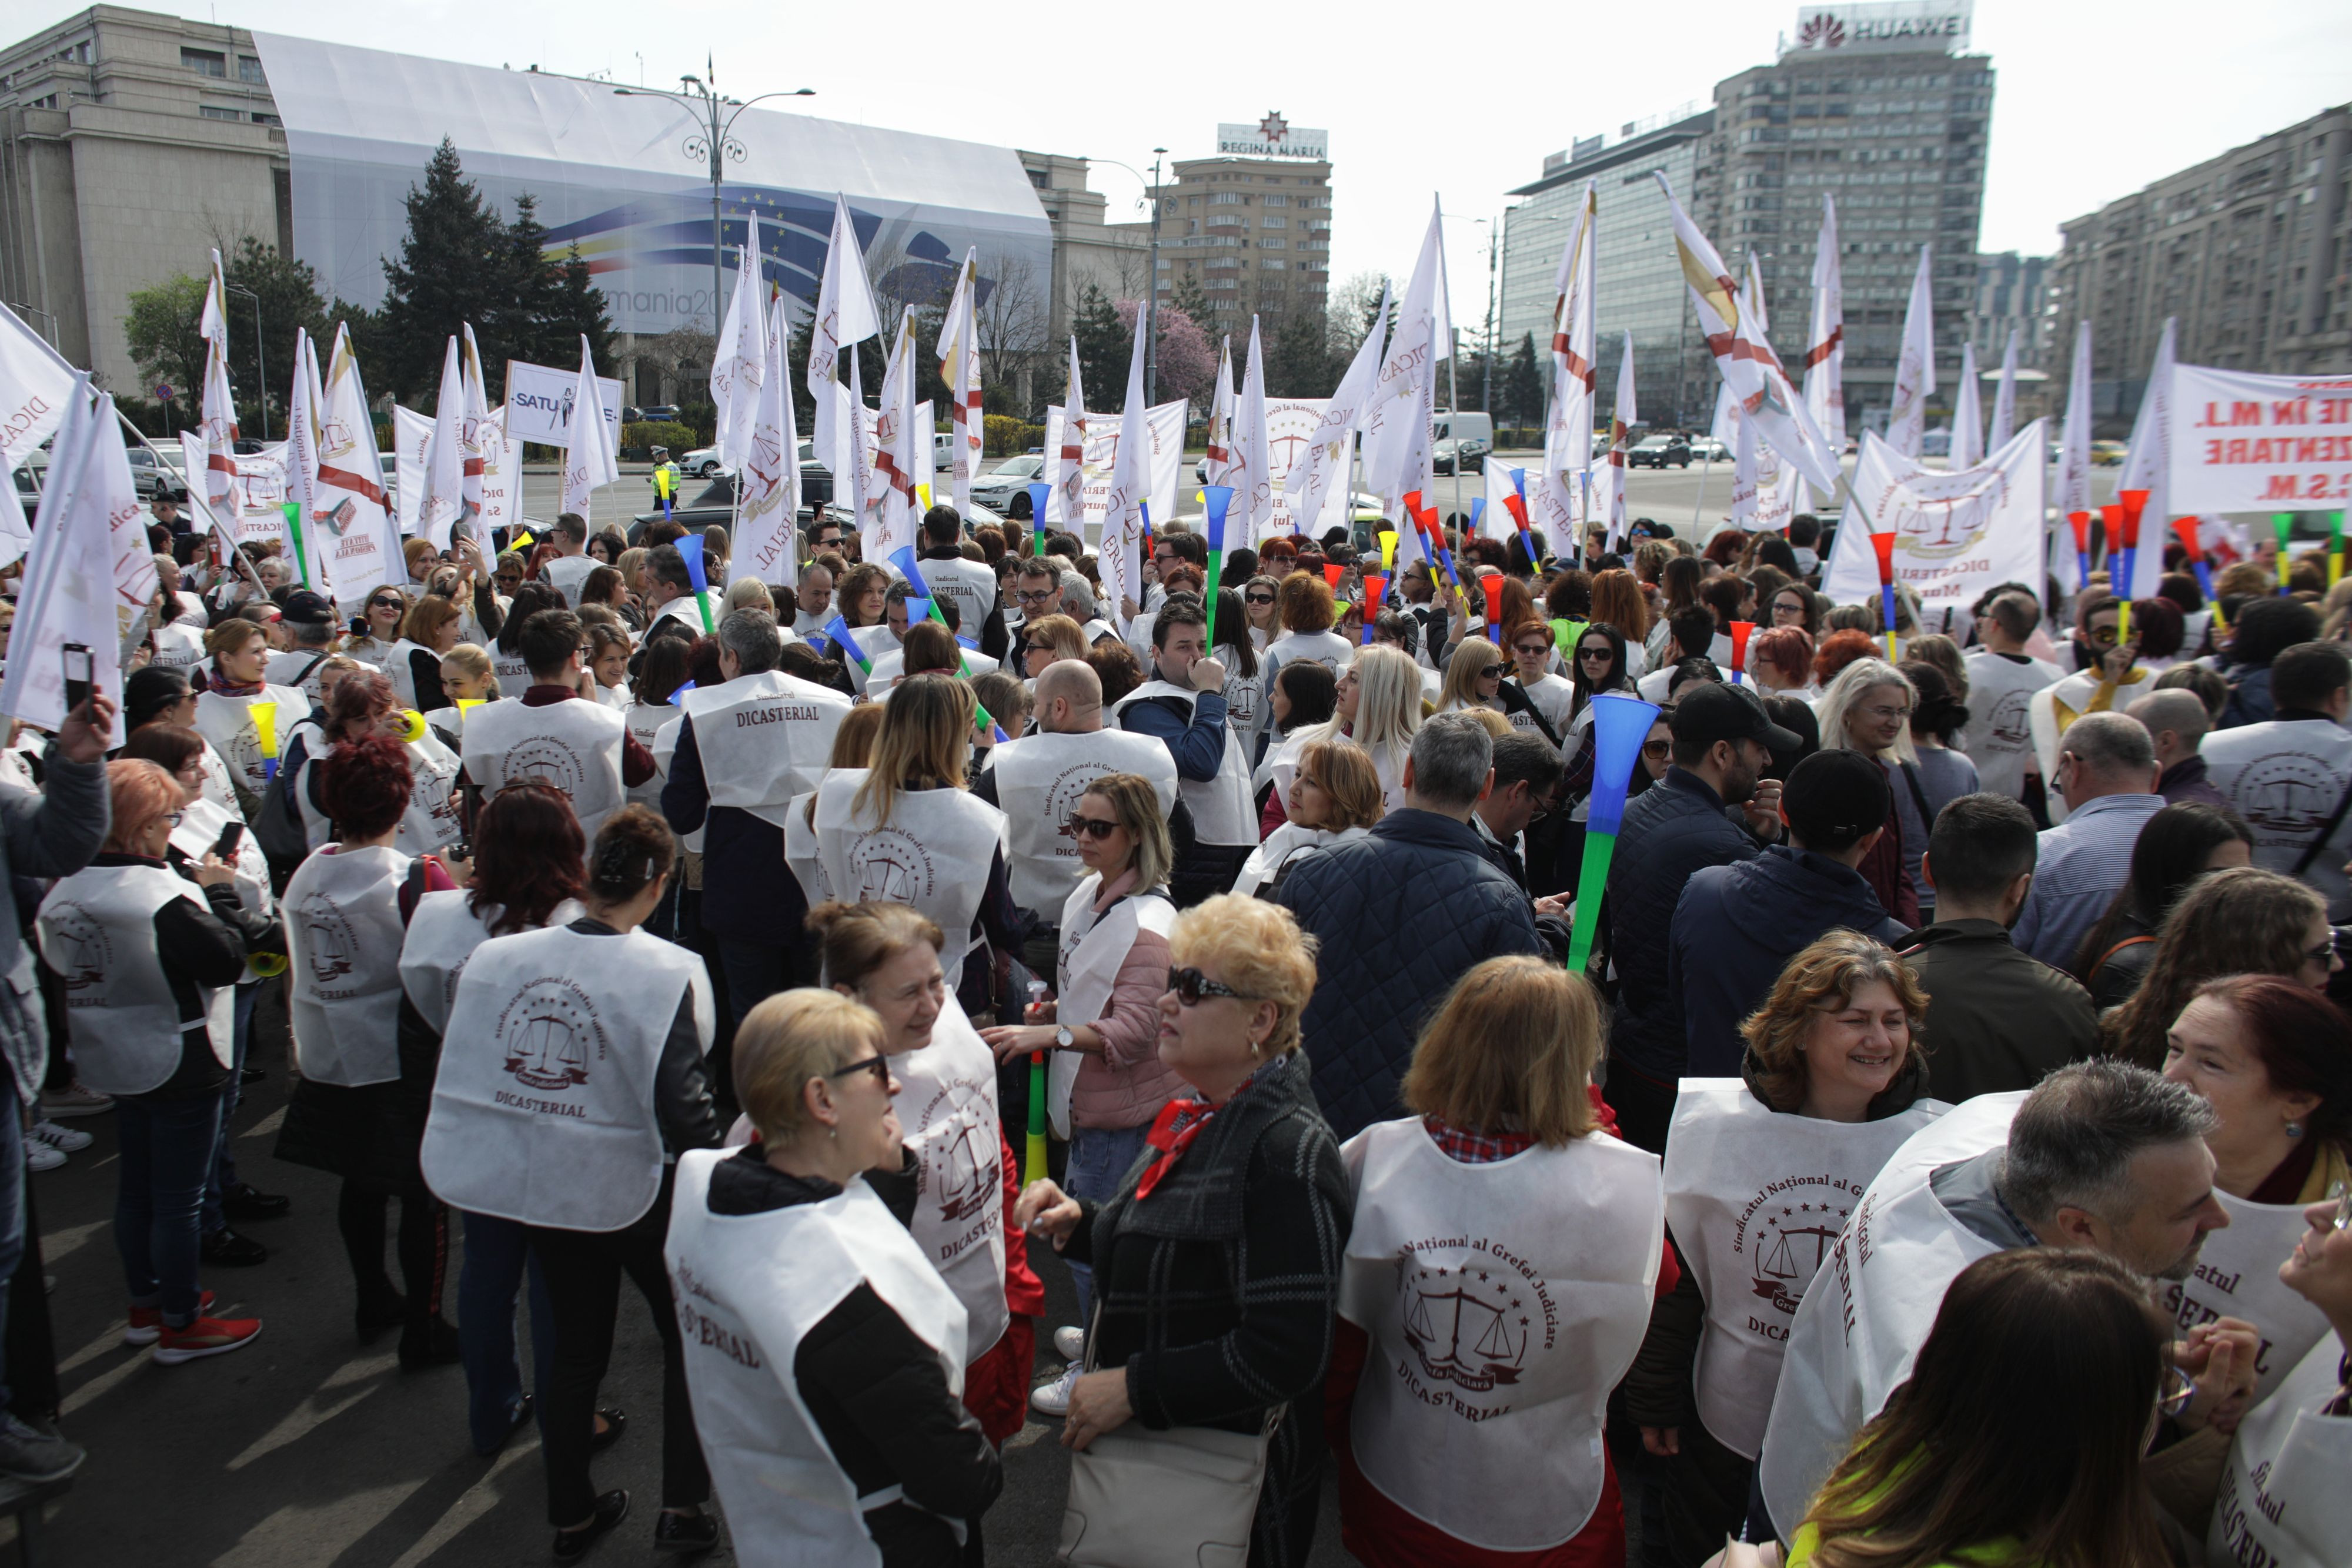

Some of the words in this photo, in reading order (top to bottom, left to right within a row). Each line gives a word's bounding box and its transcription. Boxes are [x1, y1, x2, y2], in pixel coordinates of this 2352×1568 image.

[1221, 142, 1273, 155] REGINA
[1279, 146, 1323, 158] MARIA
[515, 392, 559, 412] SATU
[756, 691, 796, 701] Sindicatul
[736, 706, 820, 728] DICASTERIAL
[549, 736, 570, 753] Grefei
[569, 750, 584, 783] Judiciare
[1044, 777, 1063, 816] Sindicatul
[1060, 761, 1091, 780] Național
[898, 828, 906, 837] al
[906, 833, 926, 855] Grefei
[923, 855, 936, 897] Judiciare
[571, 983, 595, 1011] Grefei
[495, 1090, 587, 1118] DICASTERIAL
[1733, 1191, 1768, 1254] Sindicatul
[1766, 1174, 1830, 1196] Național
[1833, 1179, 1848, 1190] al
[1404, 1234, 1469, 1255] Național
[1472, 1238, 1488, 1252] al
[1492, 1243, 1538, 1281] Grefei
[1532, 1279, 1559, 1350] Judiciare
